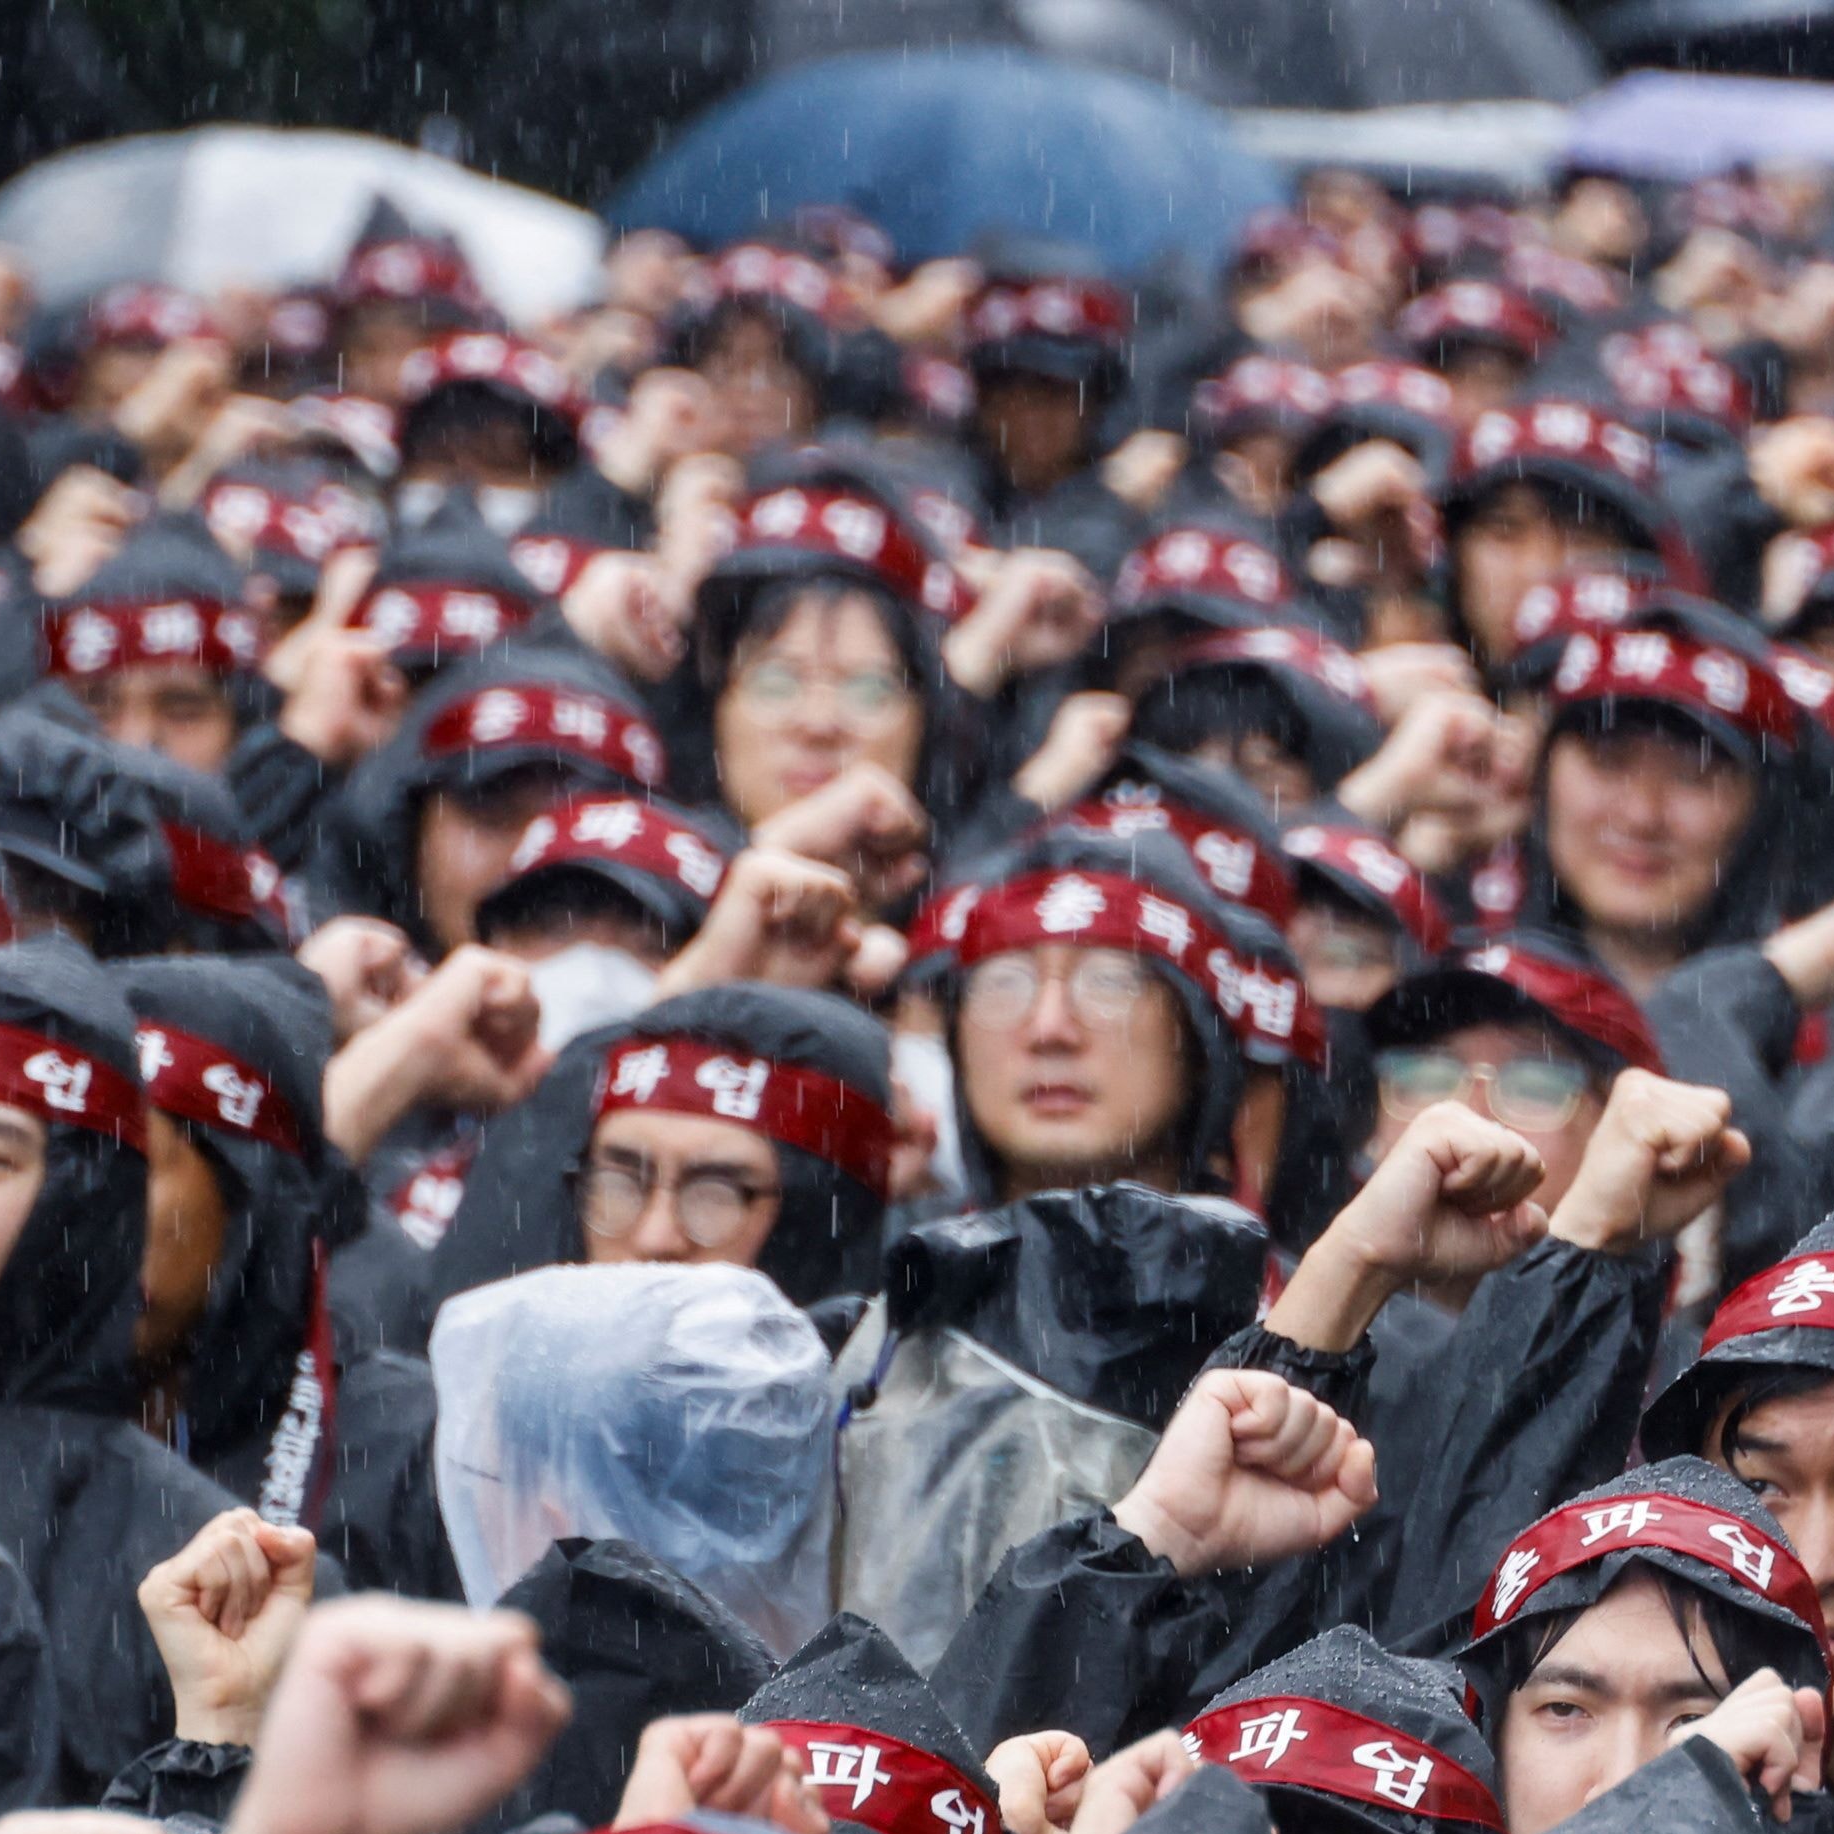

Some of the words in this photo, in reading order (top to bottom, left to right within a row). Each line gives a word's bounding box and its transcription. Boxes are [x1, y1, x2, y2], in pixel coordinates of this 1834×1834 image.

[615, 1043, 769, 1120] 파업
[1494, 1500, 1777, 1620] 총파업
[1180, 1707, 1435, 1811] 파업
